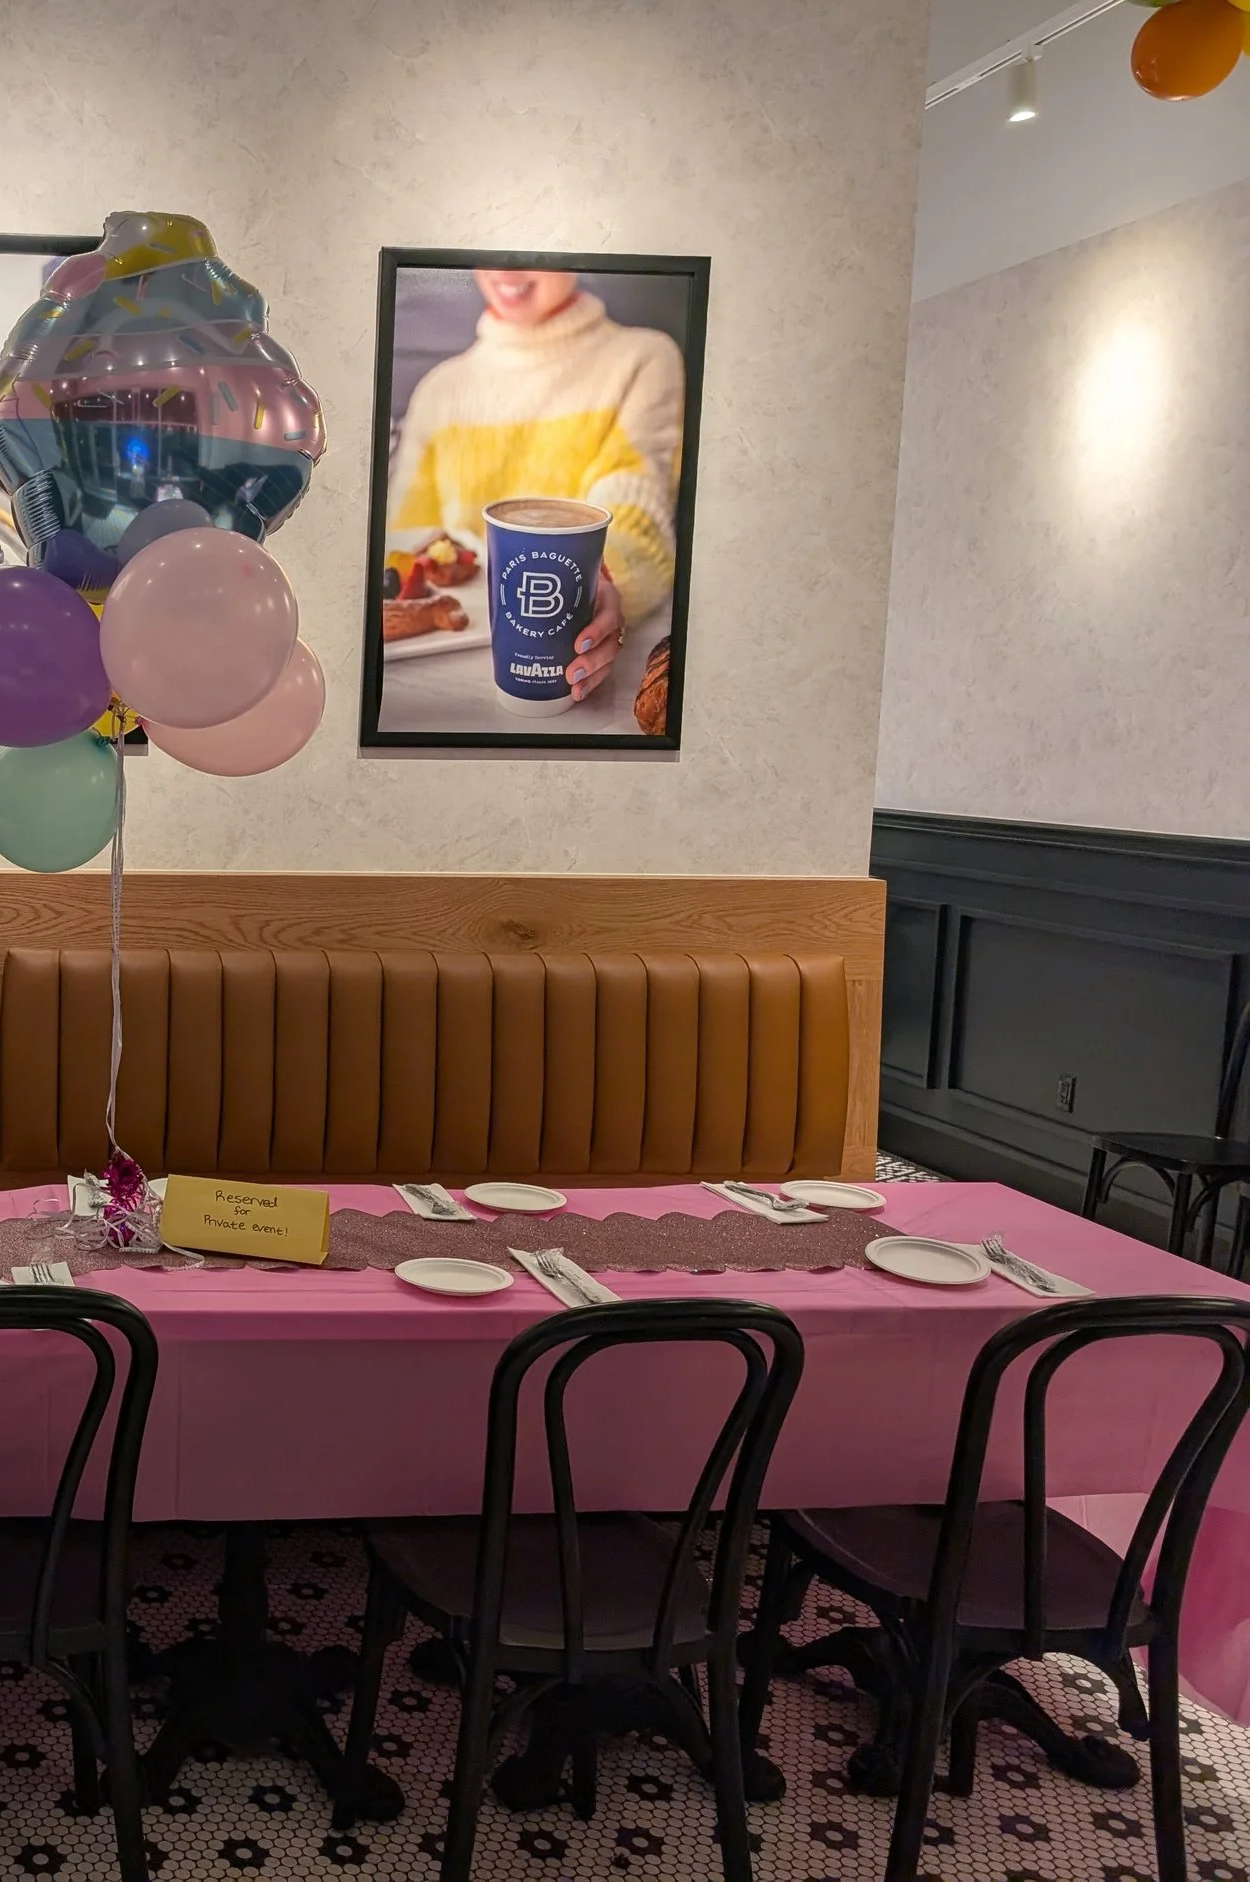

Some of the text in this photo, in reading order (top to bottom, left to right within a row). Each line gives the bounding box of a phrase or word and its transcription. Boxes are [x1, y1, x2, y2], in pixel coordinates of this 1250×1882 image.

[502, 551, 582, 582] PARIS BAGUETTE
[516, 571, 564, 618] B
[505, 611, 574, 638] BAKERY CAFÉ
[510, 662, 564, 677] LAVAZZA
[215, 1190, 278, 1208] Reserved
[233, 1206, 252, 1216] for
[204, 1214, 288, 1237] Private event!
